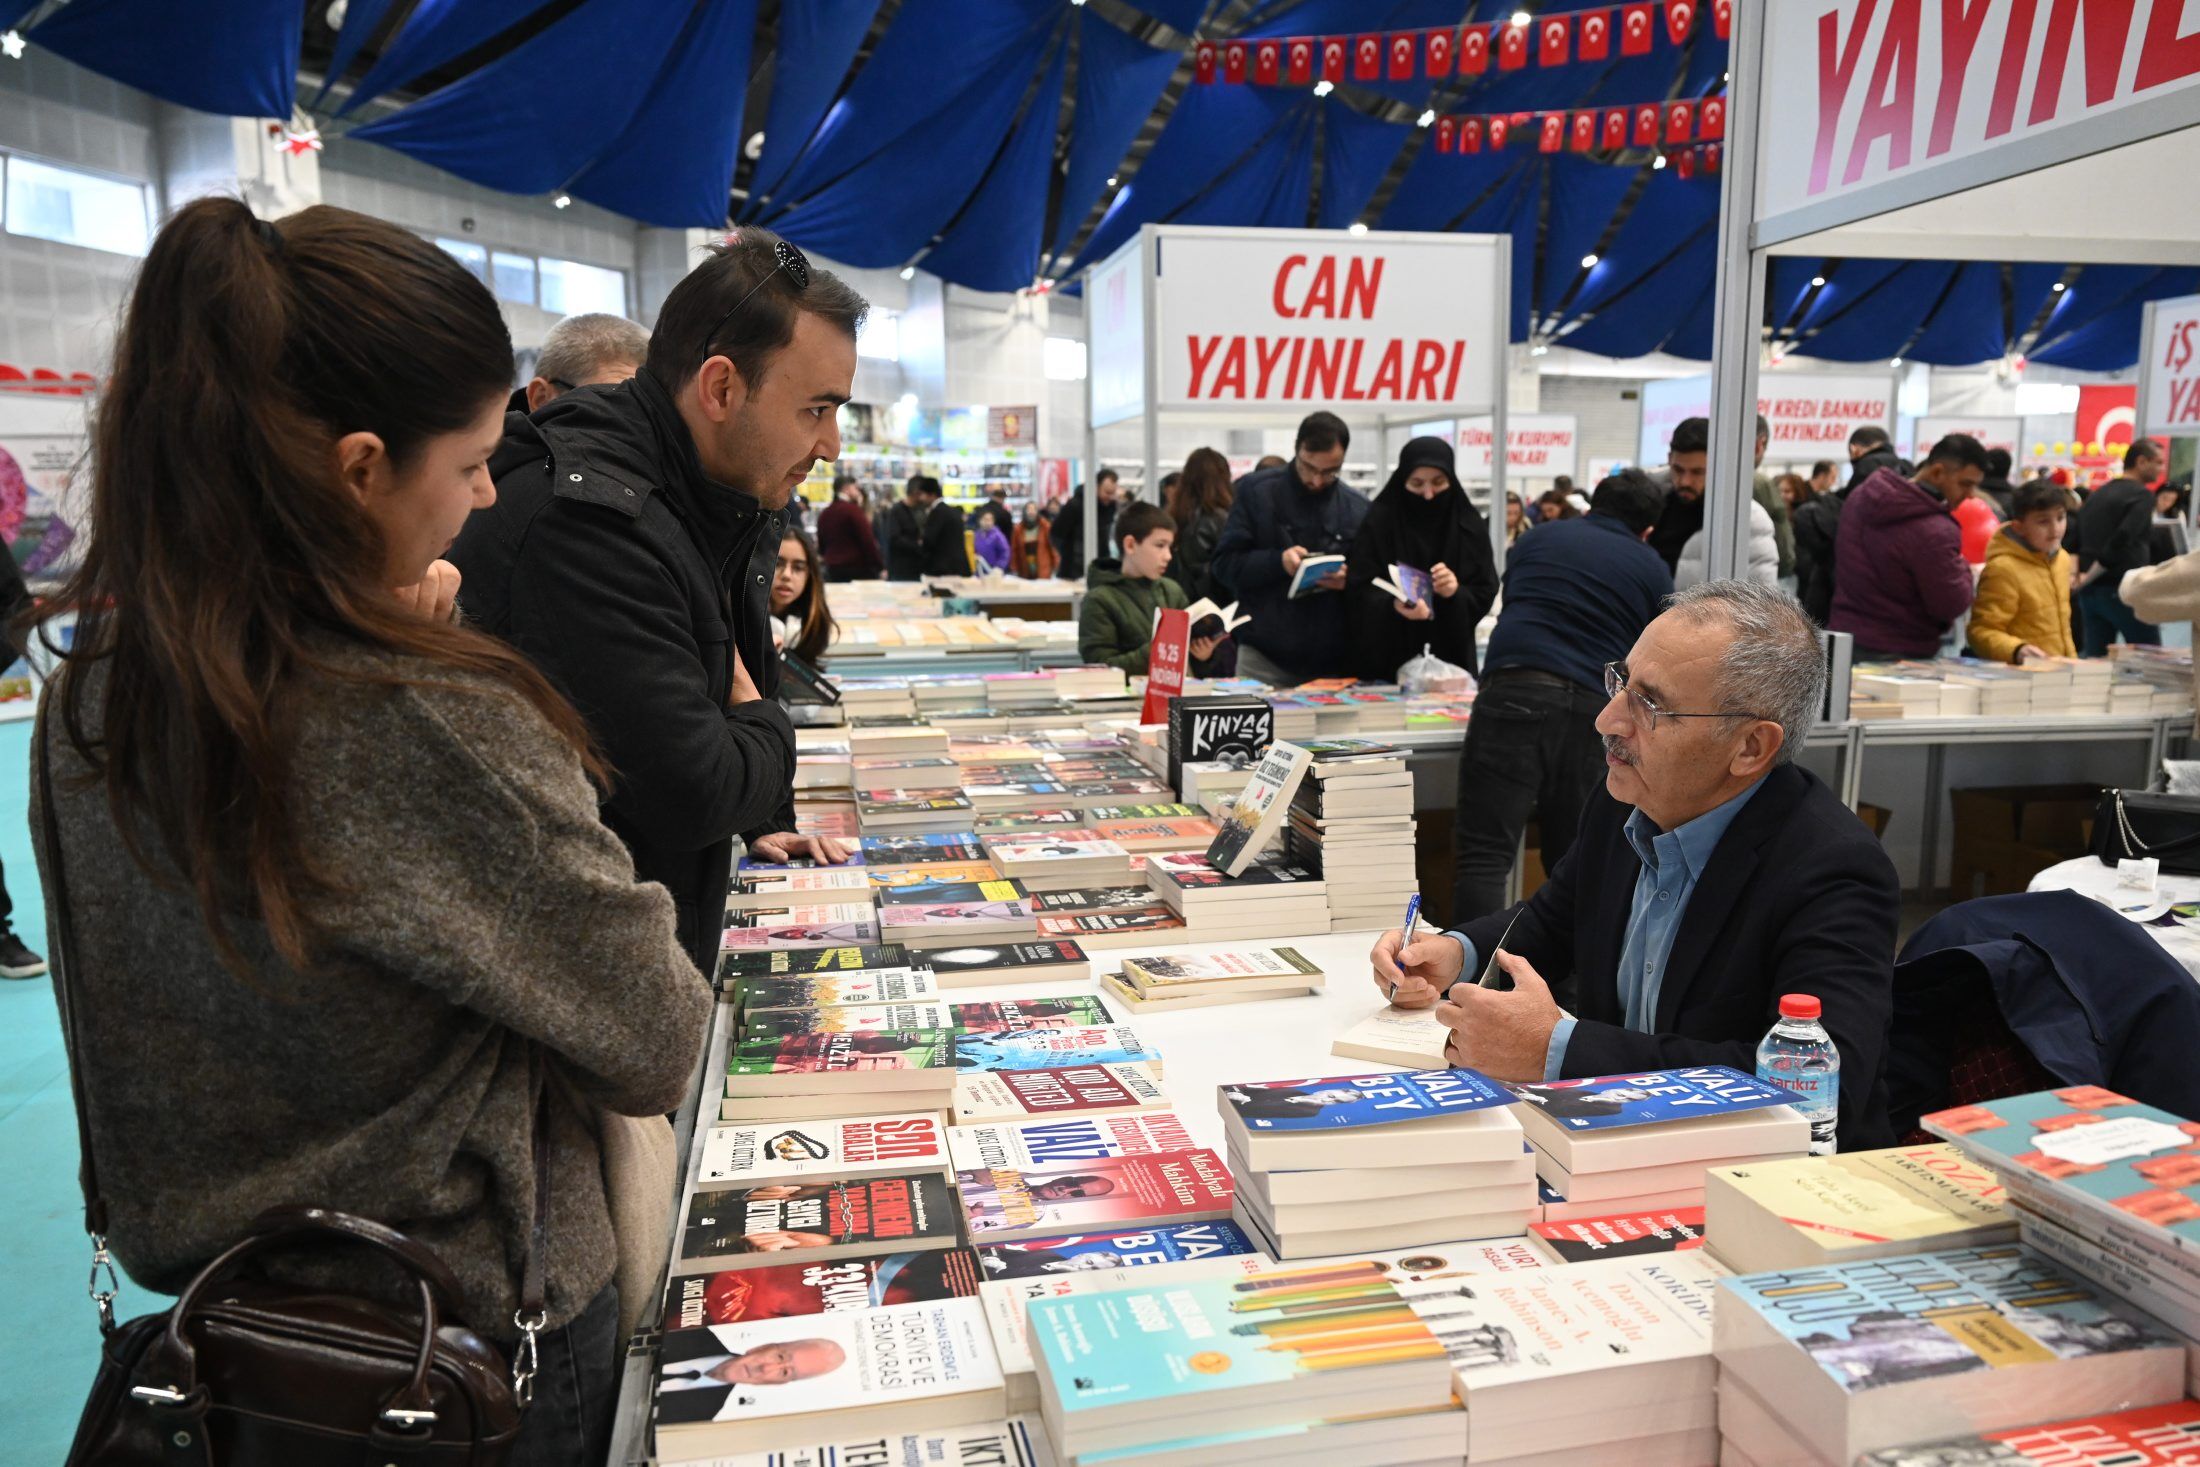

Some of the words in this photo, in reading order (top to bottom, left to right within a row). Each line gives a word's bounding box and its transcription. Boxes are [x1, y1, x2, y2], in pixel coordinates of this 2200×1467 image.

[1273, 255, 1385, 320] CAN
[2164, 319, 2199, 373] İŞ
[1187, 335, 1467, 401] YAYINLARI
[1772, 399, 1816, 418] KREDİ
[1820, 400, 1886, 419] BANKASI
[1772, 422, 1849, 442] YAYINLARI
[1482, 451, 1549, 465] YINLARI
[1150, 663, 1182, 687] İNDİRİM
[827, 1032, 855, 1071] MENZİL
[1079, 1029, 1107, 1046] Apo
[1007, 1071, 1076, 1107] MÜRTED
[1060, 1068, 1110, 1086] KOD
[1077, 1087, 1128, 1103] ADI
[1113, 1066, 1136, 1082] SAYGI
[1128, 1079, 1162, 1099] ÖZTÜRK
[1350, 1076, 1424, 1110] BEY
[1409, 1070, 1484, 1107] VALİ
[1624, 1075, 1718, 1106] BEY
[1678, 1068, 1772, 1103] VALİ
[734, 1130, 757, 1149] SAYGI
[842, 1122, 875, 1163] BABALAR
[873, 1118, 940, 1161] SON
[973, 1128, 998, 1148] SAYGI
[1019, 1120, 1118, 1164] VAİZ
[1105, 1116, 1156, 1158] ÖTESİNDEK
[1140, 1112, 1196, 1155] OKYANUS
[730, 1148, 758, 1172] ÖZTÜRK
[1185, 1152, 1229, 1198] Madalyalı
[1906, 1150, 2008, 1200] LOZA
[1158, 1161, 1197, 1206] Mahkûm
[744, 1199, 786, 1236] ÖZTÜRK
[786, 1198, 822, 1229] SAYGI
[828, 1185, 870, 1237] YAŞADIM
[868, 1179, 914, 1238] CEHENNEMİ
[1173, 1224, 1224, 1261] VA
[1637, 1216, 1673, 1240] Tırnağa
[1660, 1214, 1700, 1240] Tepeden
[1111, 1232, 1169, 1267] BE
[1501, 1243, 1543, 1269] YURT
[683, 1278, 705, 1299] SAYGI
[801, 1262, 867, 1288] 33
[821, 1280, 871, 1313] KUR
[1527, 1284, 1570, 1326] James
[1569, 1276, 1646, 1342] Acemoğlu
[1608, 1282, 1661, 1325] Daron
[1642, 1266, 1713, 1323] KORİDO
[680, 1298, 708, 1329] ÖZTÜRK
[1493, 1286, 1564, 1351] Robinson
[870, 1314, 908, 1391] DEMOKRASİ
[901, 1310, 932, 1368] TÜRKİYE
[911, 1368, 936, 1387] VE
